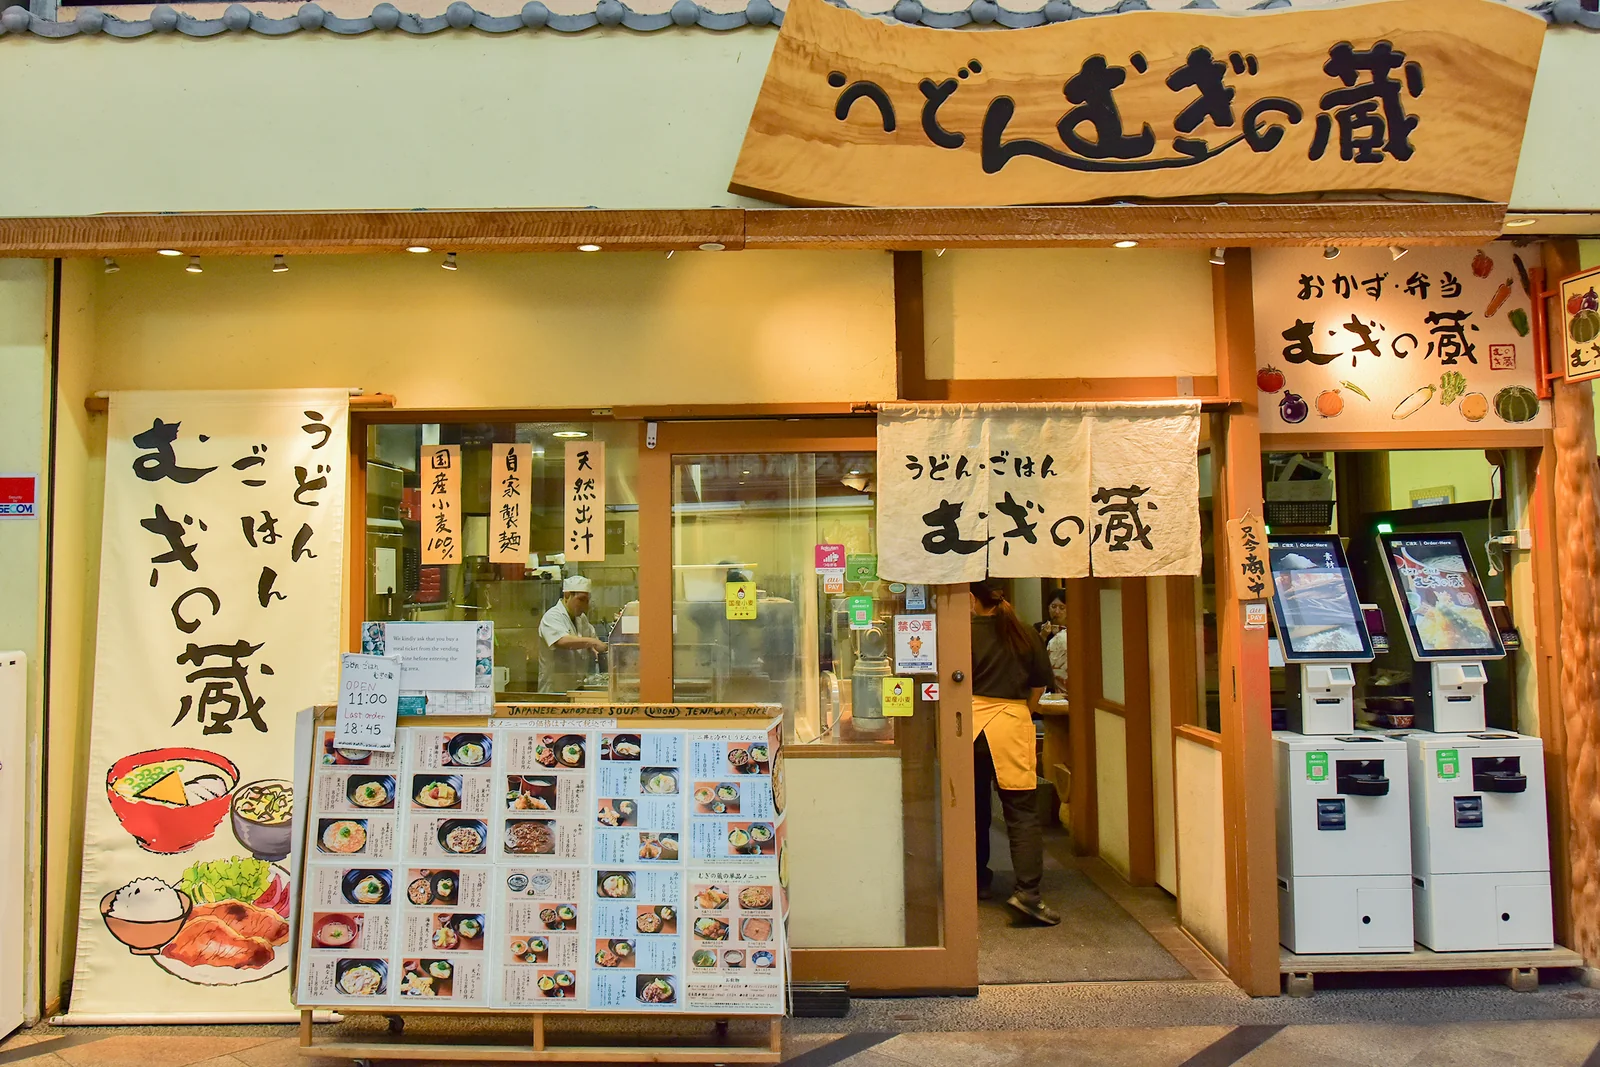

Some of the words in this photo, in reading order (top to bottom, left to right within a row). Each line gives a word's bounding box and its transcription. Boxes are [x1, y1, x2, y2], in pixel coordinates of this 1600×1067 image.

[1281, 309, 1480, 367] むぎの蔵
[292, 410, 333, 562] うどん
[905, 450, 1058, 480] うどん・ごはん
[232, 443, 288, 608] ごはん
[498, 447, 521, 554] 自家製麺
[570, 450, 597, 555] 天然出汁
[921, 485, 1158, 556] むぎの蔵
[132, 417, 275, 735] むぎの蔵
[1240, 526, 1266, 599] 只今商い中
[401, 635, 416, 643] kindly
[343, 708, 362, 719] Last
[365, 711, 386, 720] order
[345, 680, 377, 692] OPEN
[348, 692, 388, 706] 11:00
[506, 706, 557, 716] JAPANESE
[343, 722, 382, 736] 18:45
